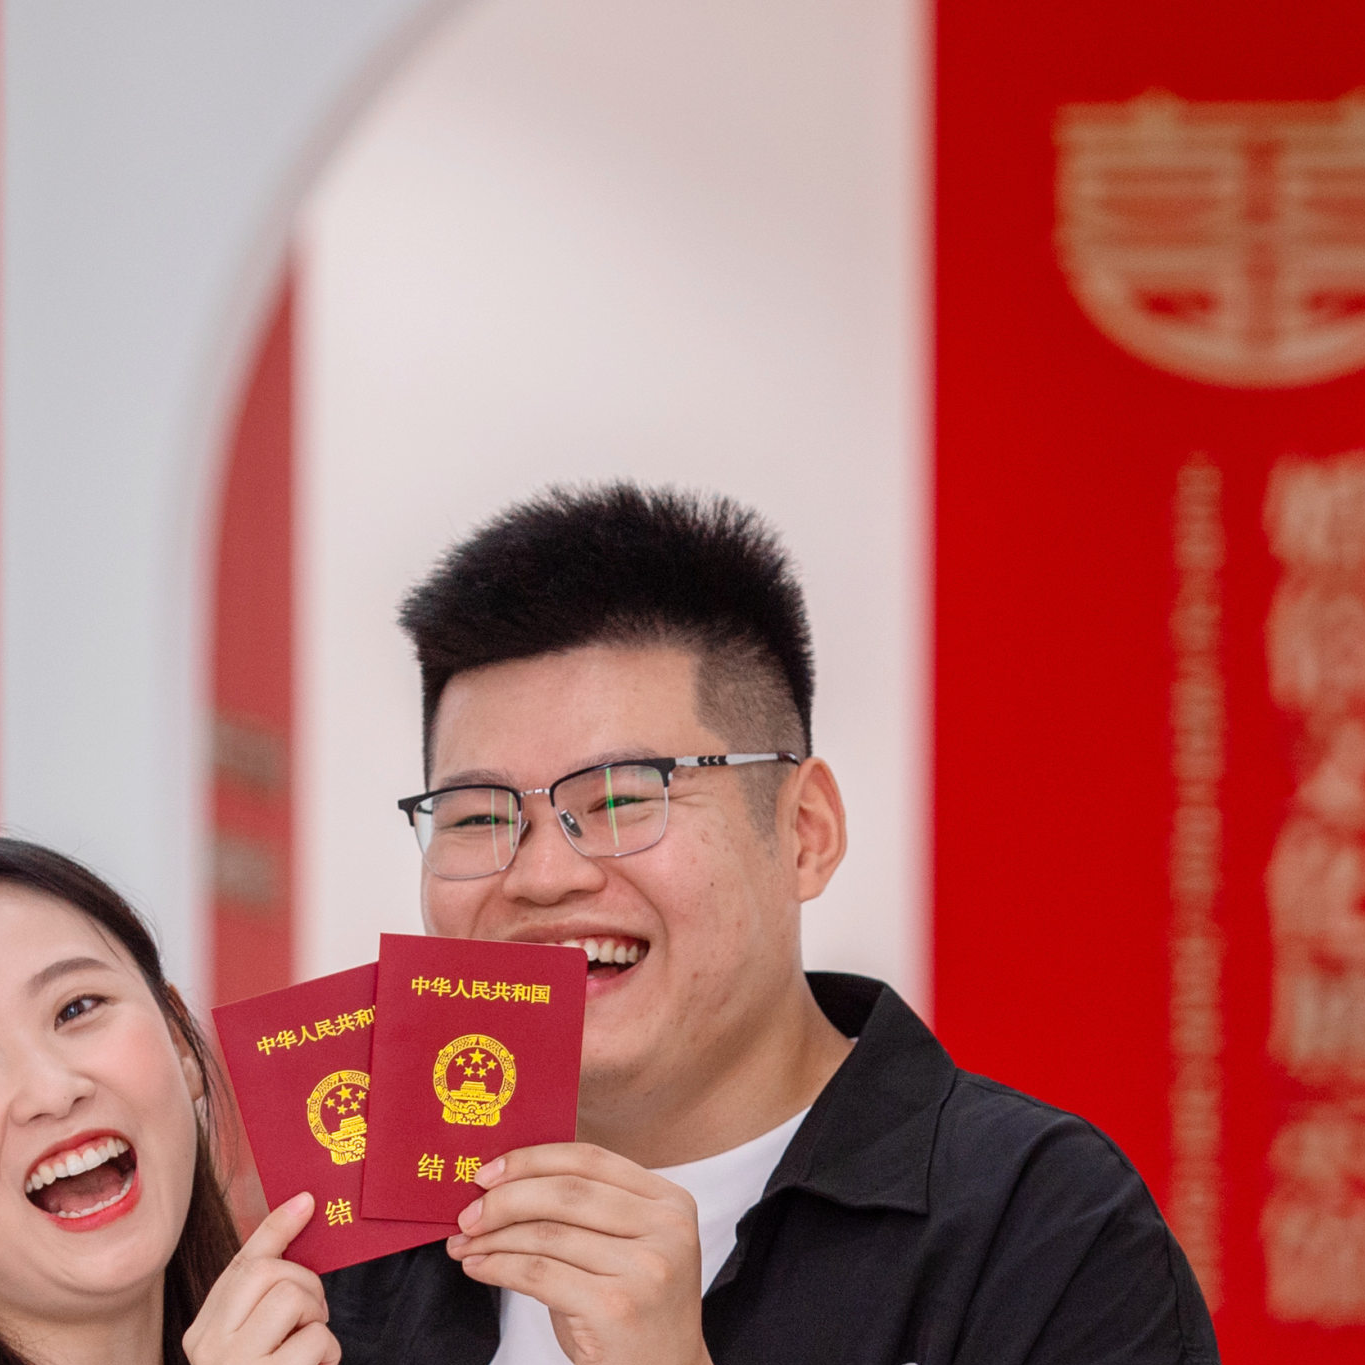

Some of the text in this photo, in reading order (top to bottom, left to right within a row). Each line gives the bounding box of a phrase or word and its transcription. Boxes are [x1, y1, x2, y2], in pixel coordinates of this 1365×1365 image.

[411, 975, 551, 1004] 中华人民共和国
[256, 1005, 376, 1056] 中华人民共和
[325, 1198, 353, 1226] 结
